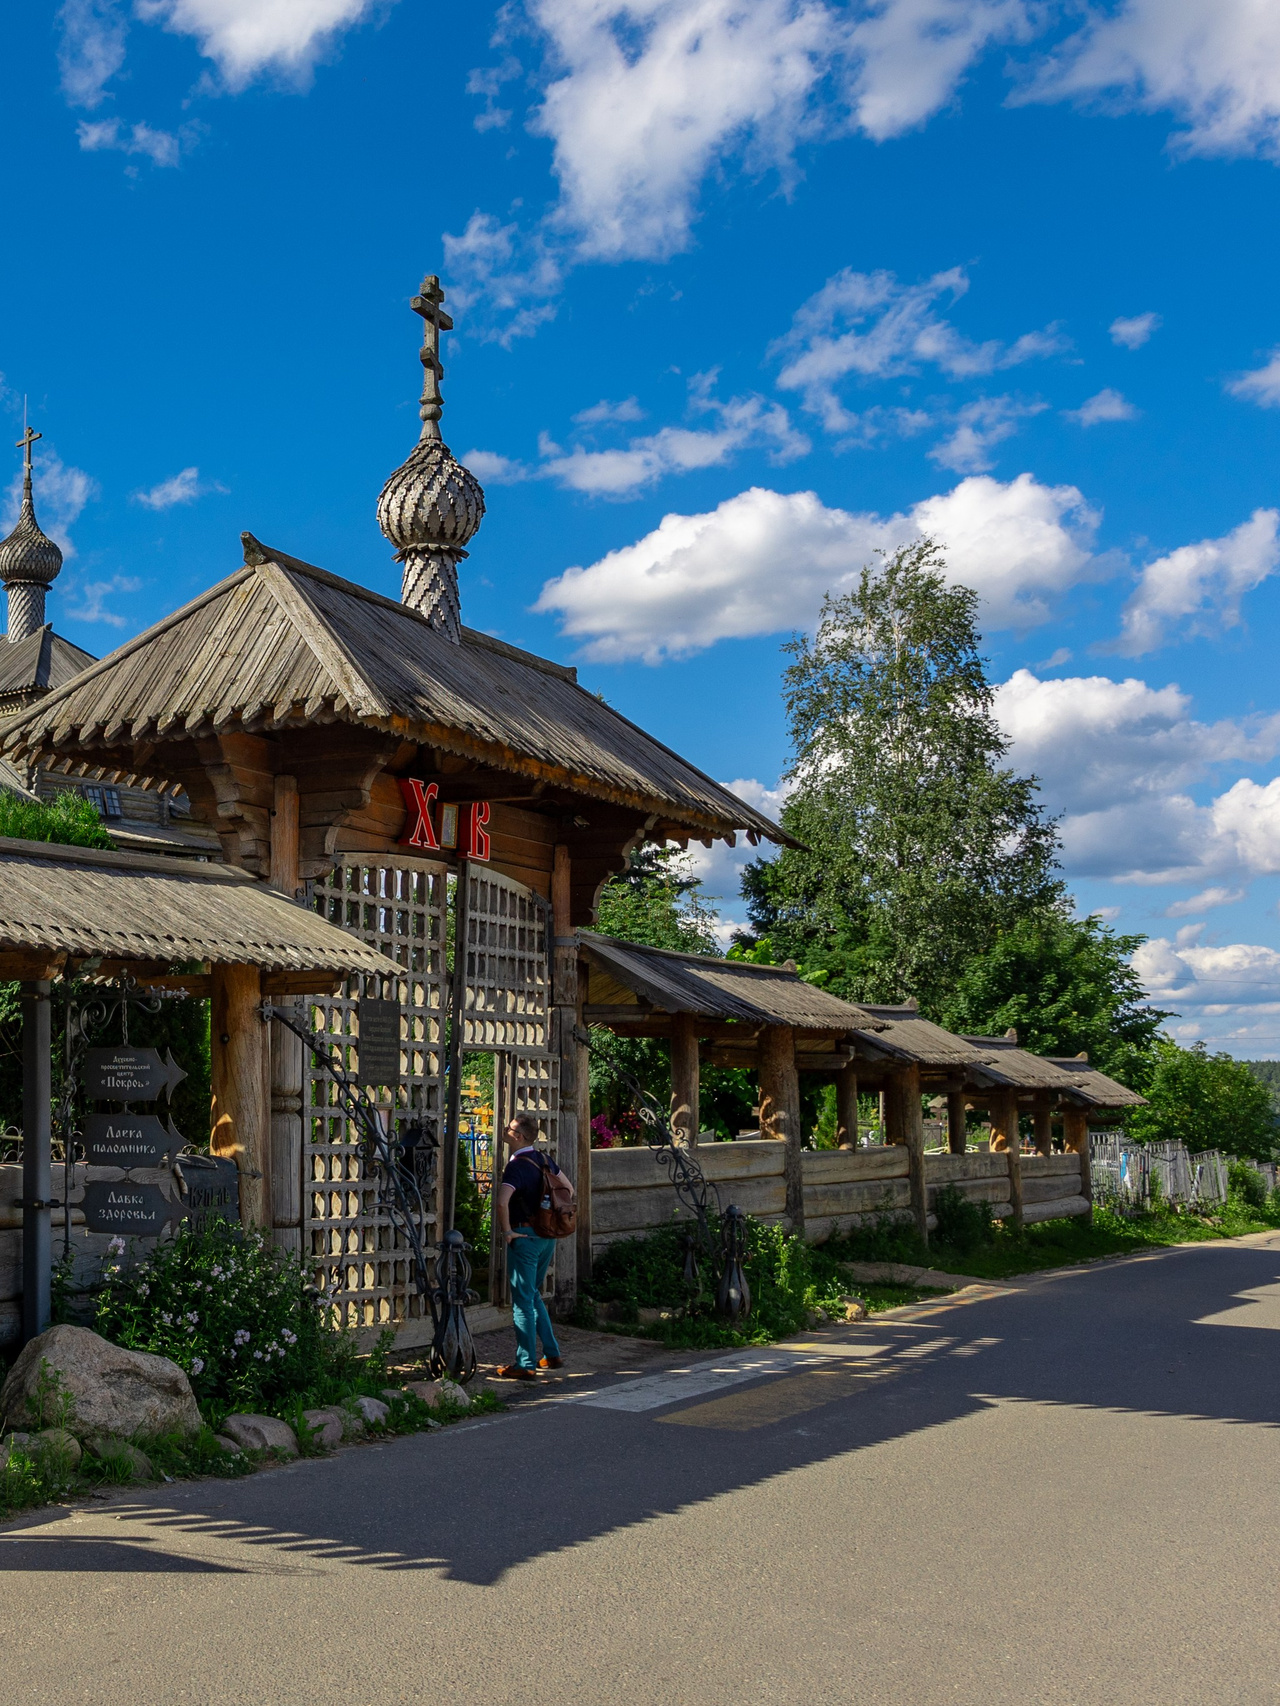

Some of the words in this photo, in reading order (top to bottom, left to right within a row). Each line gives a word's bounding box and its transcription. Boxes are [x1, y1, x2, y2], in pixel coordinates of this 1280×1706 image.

[409, 778, 440, 850] Х
[468, 802, 490, 861] В
[101, 1076, 150, 1090] «Покров»
[106, 1126, 142, 1138] Лавка
[93, 1144, 156, 1154] паломника
[108, 1191, 144, 1204] Лавка
[189, 1187, 231, 1208] КУПЛЬ
[98, 1208, 156, 1221] здоровья
